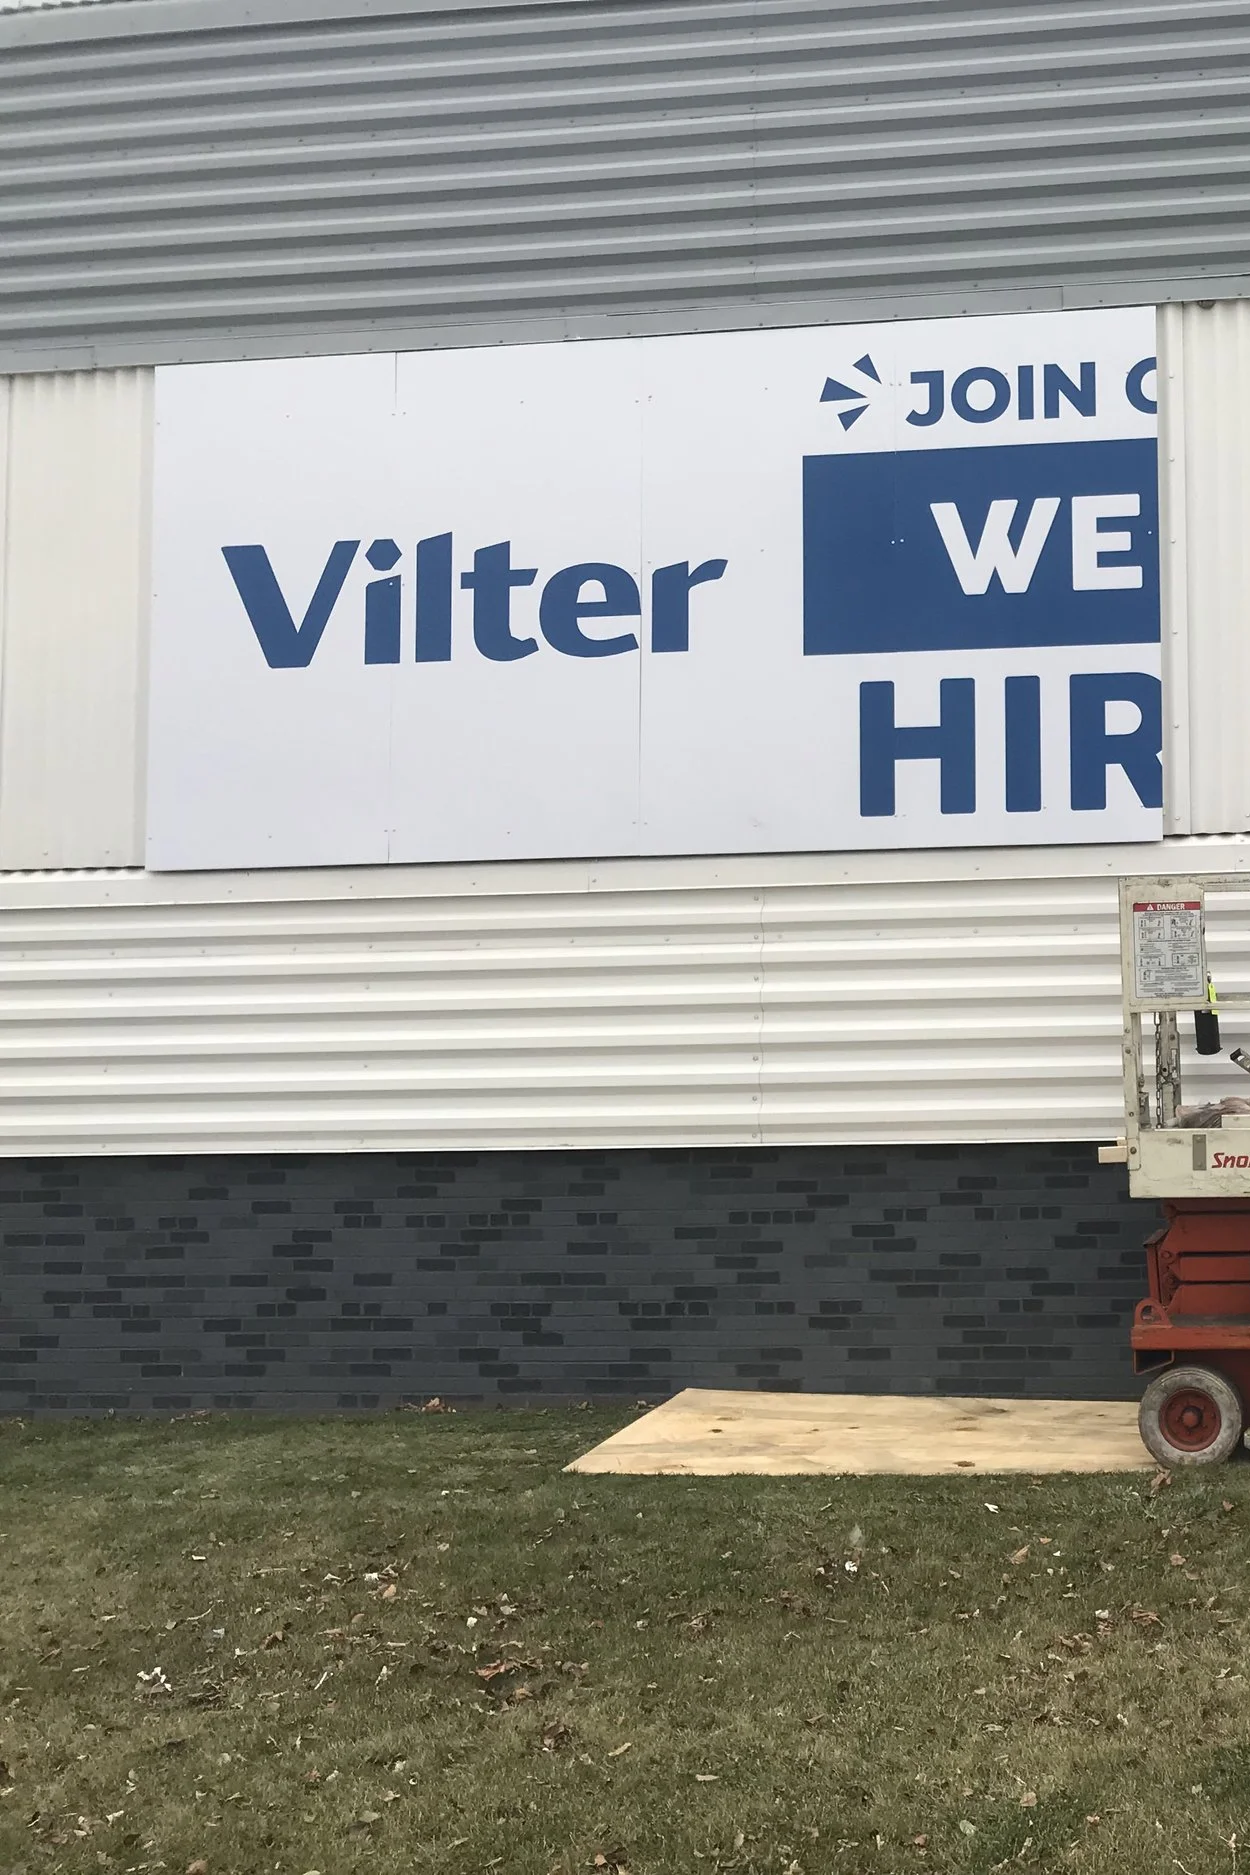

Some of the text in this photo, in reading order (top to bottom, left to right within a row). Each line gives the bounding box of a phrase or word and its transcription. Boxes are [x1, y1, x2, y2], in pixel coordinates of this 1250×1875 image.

[905, 361, 1097, 427] JOIN
[929, 493, 1143, 595] WE
[220, 531, 729, 669] Vilter
[859, 672, 1163, 817] HIR
[1156, 903, 1186, 911] DANGER
